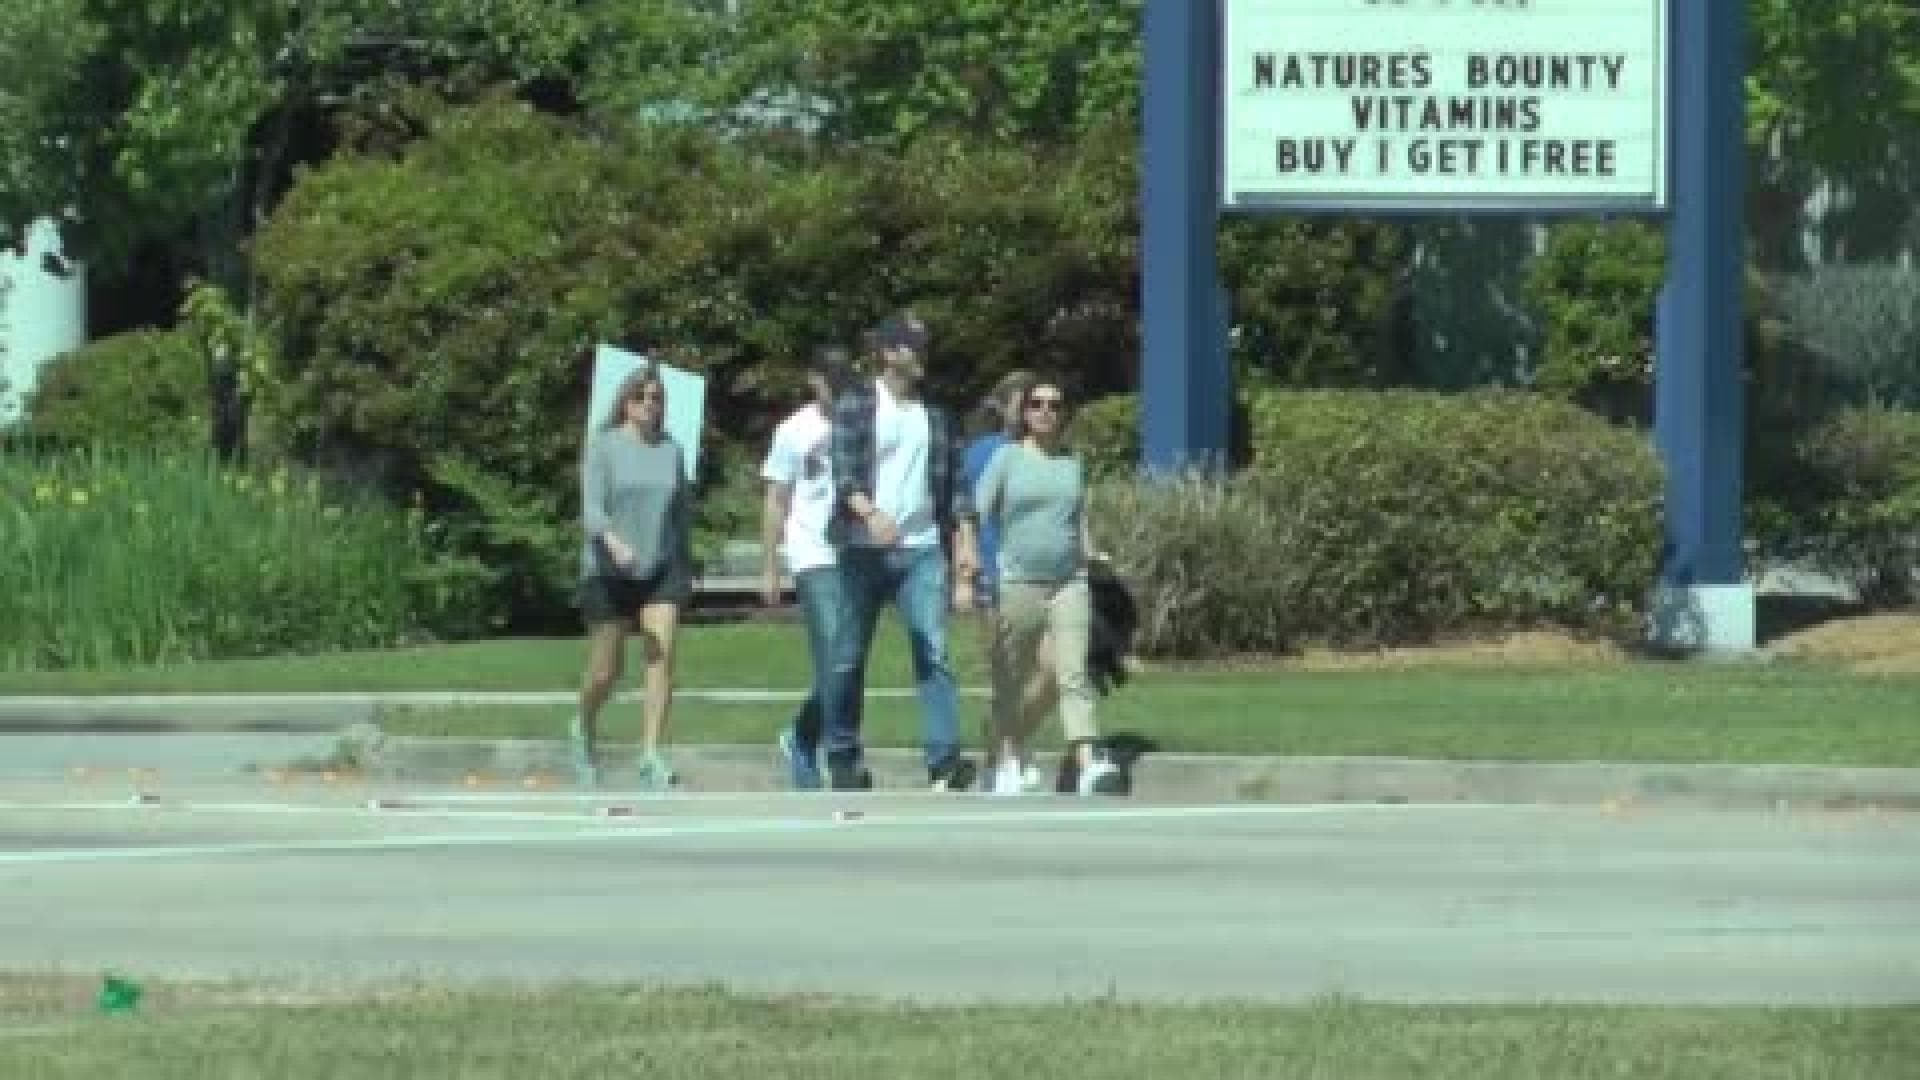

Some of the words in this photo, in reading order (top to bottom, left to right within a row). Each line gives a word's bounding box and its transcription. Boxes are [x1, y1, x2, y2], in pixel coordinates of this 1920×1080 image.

[1253, 52, 1432, 89] NATURES
[1467, 53, 1627, 90] BOUNTY
[1352, 95, 1540, 131] VITAMINS
[1277, 139, 1357, 175] BUY
[1407, 139, 1485, 175] GET
[1518, 139, 1617, 175] FREE
